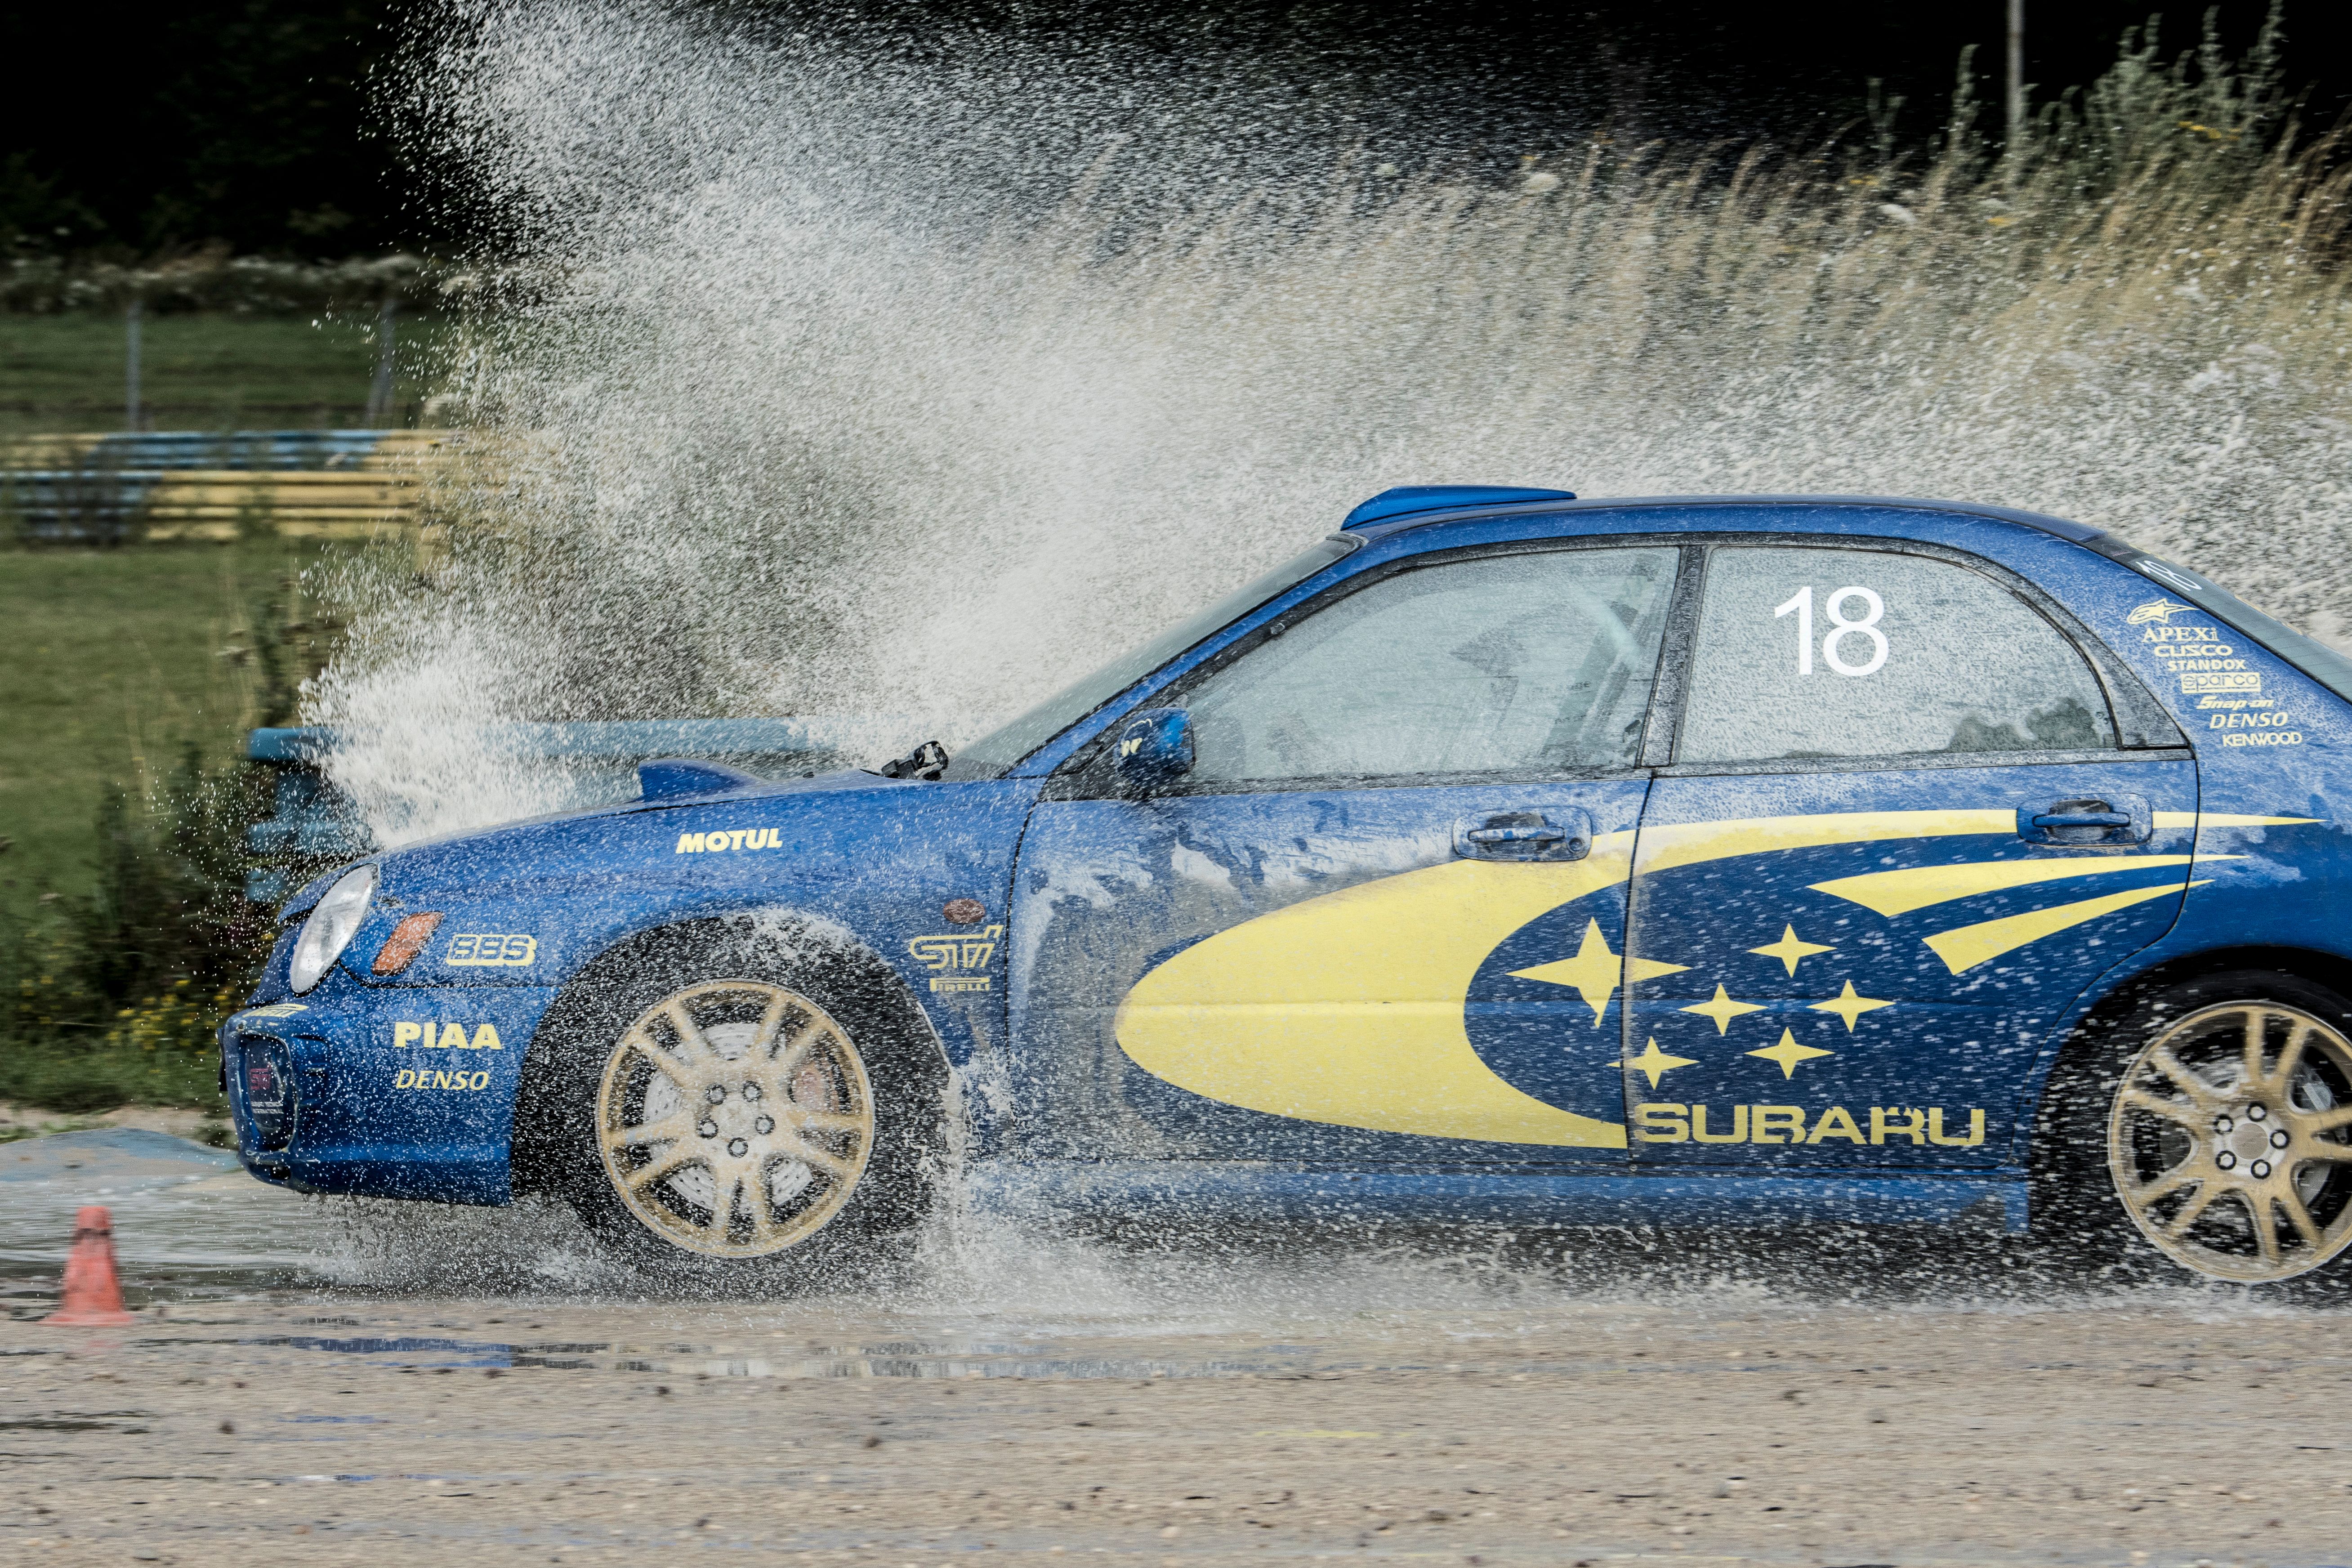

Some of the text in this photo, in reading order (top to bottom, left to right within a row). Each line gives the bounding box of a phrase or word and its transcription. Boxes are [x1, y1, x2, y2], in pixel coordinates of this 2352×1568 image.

[2136, 560, 2202, 591] 18
[1775, 586, 1888, 676] 18
[2154, 645, 2233, 657] CUSCO
[2167, 659, 2246, 671] STANDOX
[2182, 675, 2258, 692] sparco
[2196, 696, 2274, 710] Snap-on
[2209, 712, 2288, 728] DENSO
[2222, 732, 2303, 746] KENWOOD
[675, 828, 783, 853] MOTUL
[446, 934, 537, 966] BBS
[929, 977, 990, 992] PIRELLI
[394, 1022, 502, 1050] PIAA
[396, 1070, 490, 1090] DENSO
[1634, 1103, 1985, 1145] SUBARU
